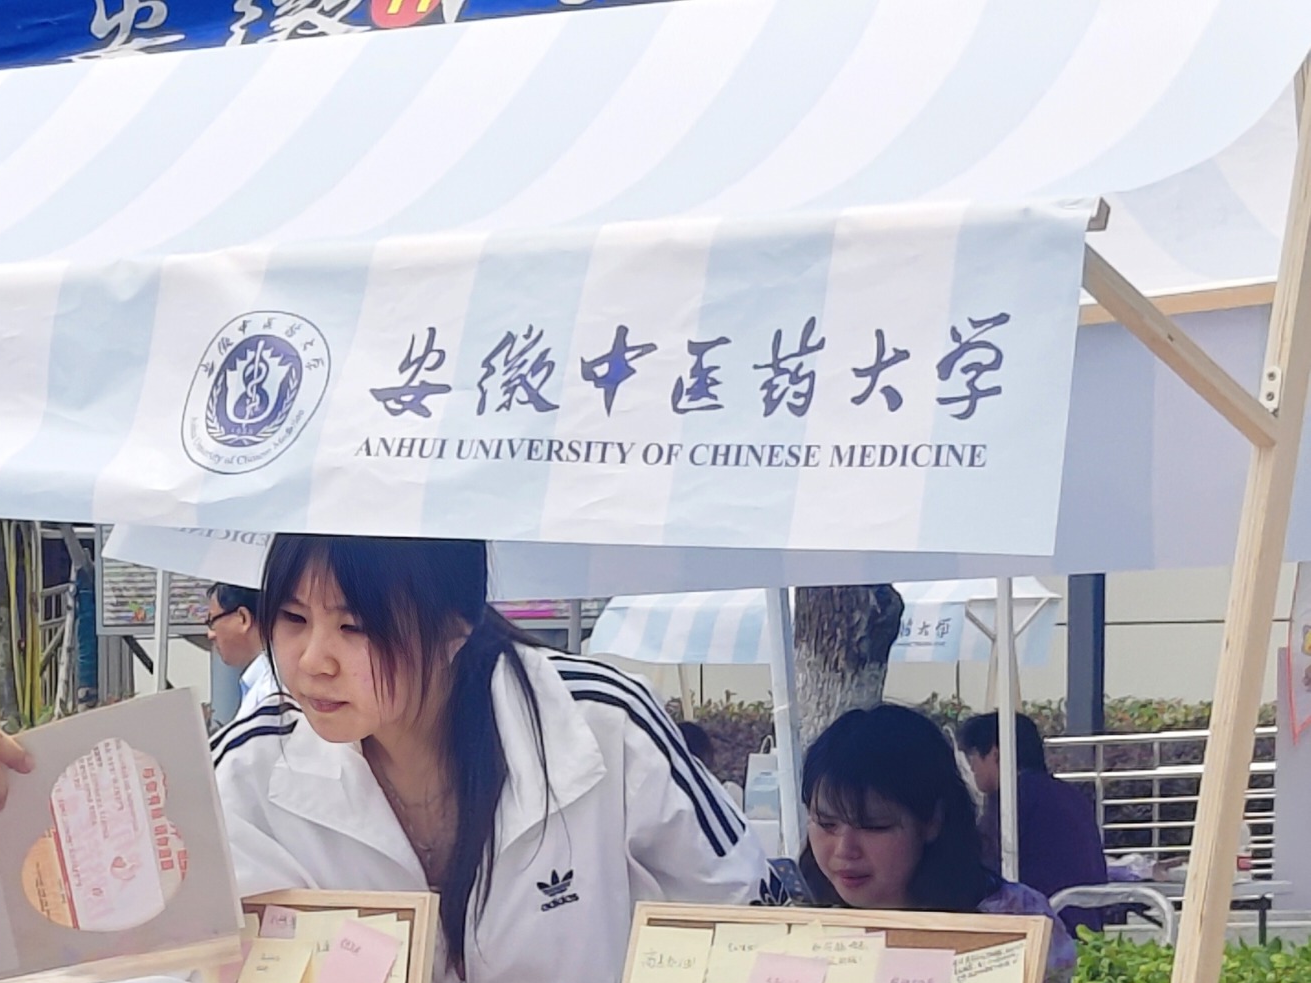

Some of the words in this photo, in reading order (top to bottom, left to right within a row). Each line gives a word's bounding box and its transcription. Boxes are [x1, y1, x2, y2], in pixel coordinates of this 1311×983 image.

[370, 312, 1011, 420] 安徽中医药大学
[354, 436, 449, 461] ANHUI
[456, 438, 636, 464] UNIVERSITY
[642, 443, 683, 466] OF
[689, 443, 822, 469] CHINESE
[829, 443, 988, 469] MEDICINE
